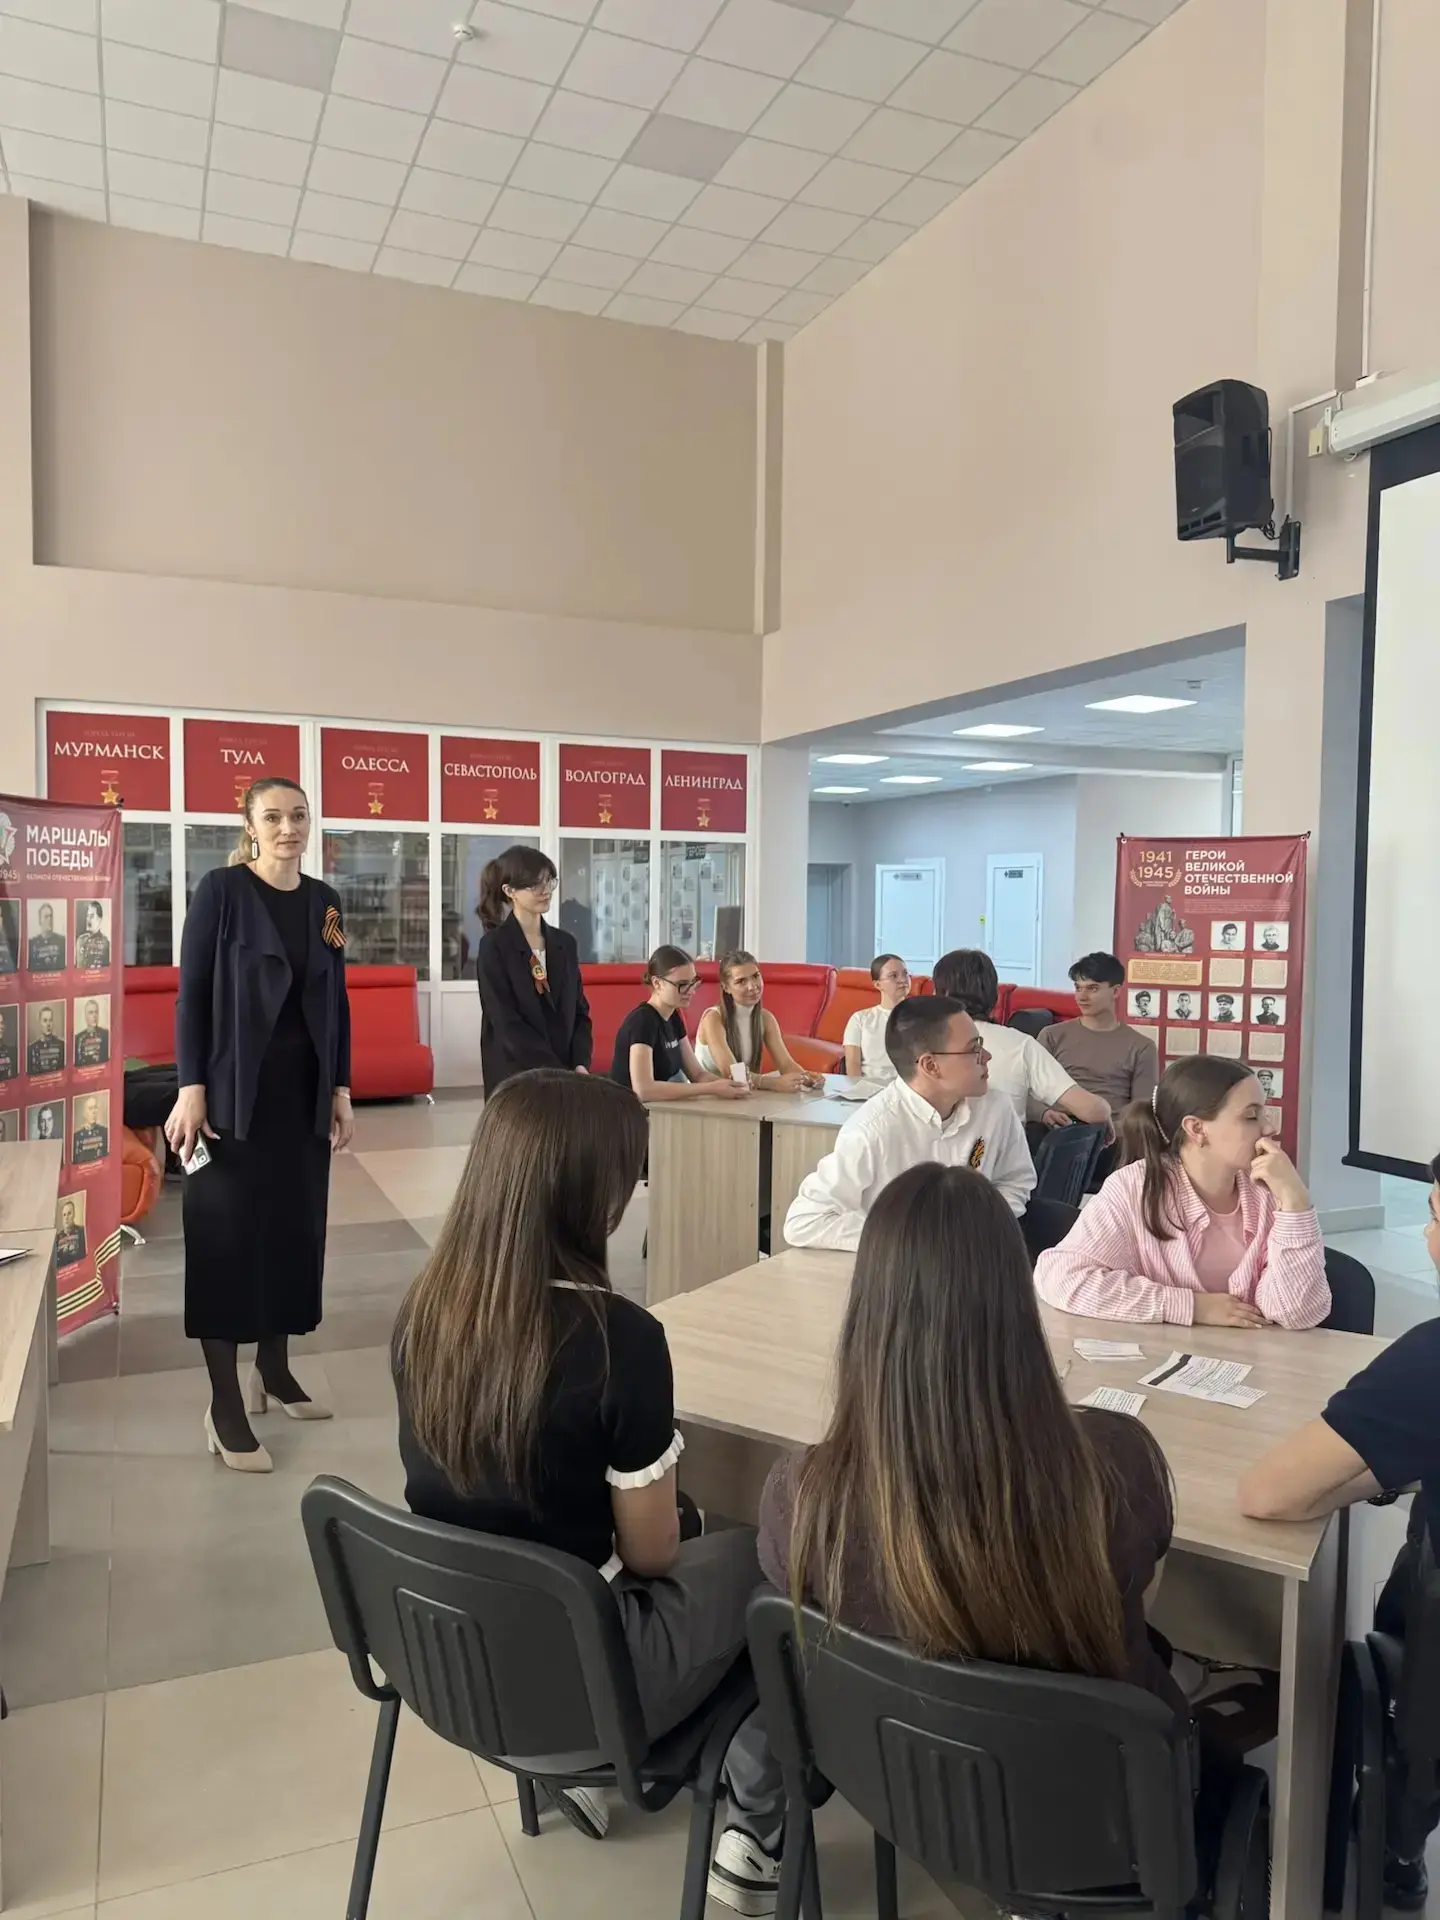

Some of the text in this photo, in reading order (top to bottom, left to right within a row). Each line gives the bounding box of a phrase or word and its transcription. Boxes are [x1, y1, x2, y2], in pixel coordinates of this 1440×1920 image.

[54, 741, 165, 760] МУРМАНСК
[220, 748, 265, 765] ТУЛА
[341, 756, 410, 773] ОДЕССА
[444, 763, 537, 780] СЕВАСТОПОЛЬ
[565, 769, 646, 786] ВОЛГОГРАД
[665, 775, 743, 791] ЛЕНИНГРАД
[26, 825, 110, 847] МАРШАЛЫ
[26, 848, 93, 870] ПОБЕДЫ
[1139, 850, 1172, 863] 1941
[1185, 850, 1226, 860] ГЕРОИ
[1137, 866, 1174, 879] 1945
[1185, 860, 1245, 872] ВЕЛИКОЙ
[1184, 872, 1294, 884] ОТЕЧЕСТВЕННОЙ
[1184, 883, 1231, 895] ВОЙНЫ
